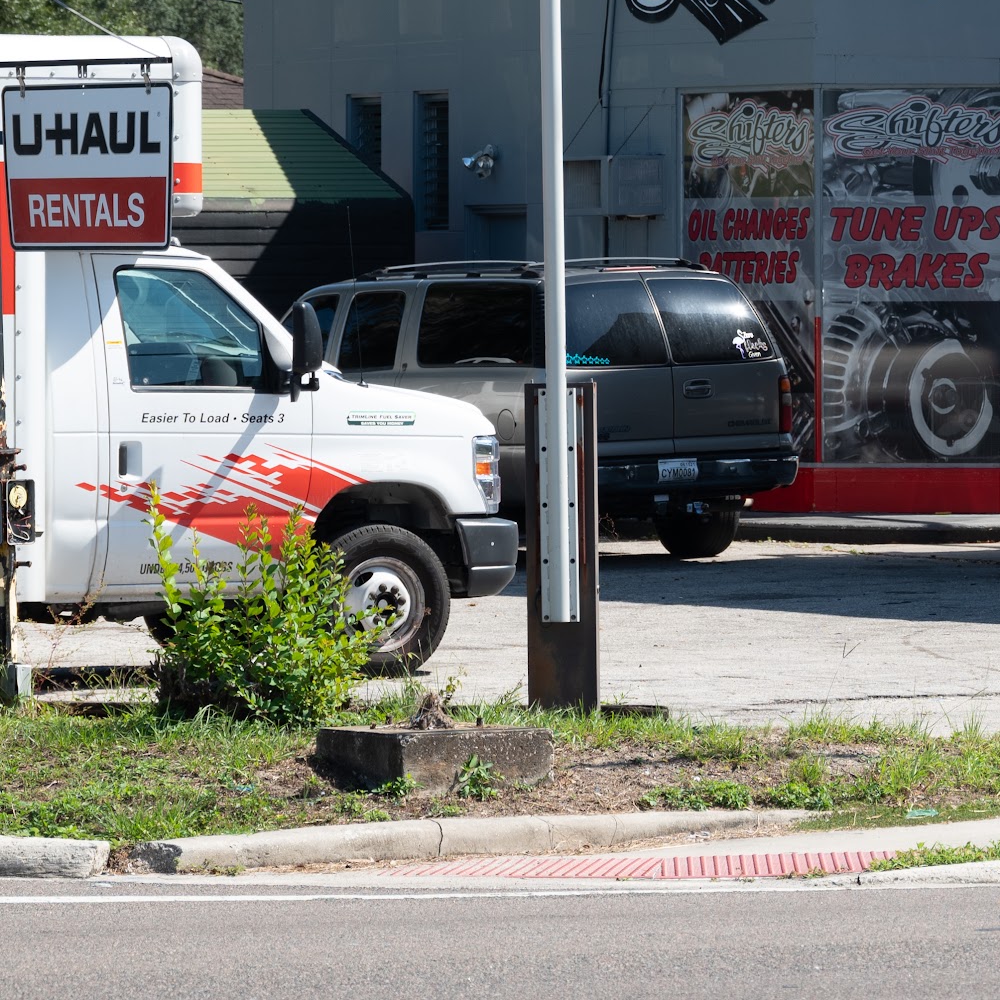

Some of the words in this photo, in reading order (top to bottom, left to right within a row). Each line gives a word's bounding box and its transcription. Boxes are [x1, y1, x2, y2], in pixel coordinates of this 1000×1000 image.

[12, 111, 161, 156] U-HAUL
[688, 101, 810, 165] Shifters
[28, 192, 145, 228] RENTALS
[688, 208, 718, 241] OIL
[723, 207, 811, 241] CHANGES
[830, 206, 926, 241] TUNE
[844, 253, 990, 291] BRAKES
[141, 412, 178, 424] Easier
[183, 412, 196, 424] To
[200, 412, 230, 424] Load
[240, 412, 274, 424] Seats
[278, 413, 285, 424] 3
